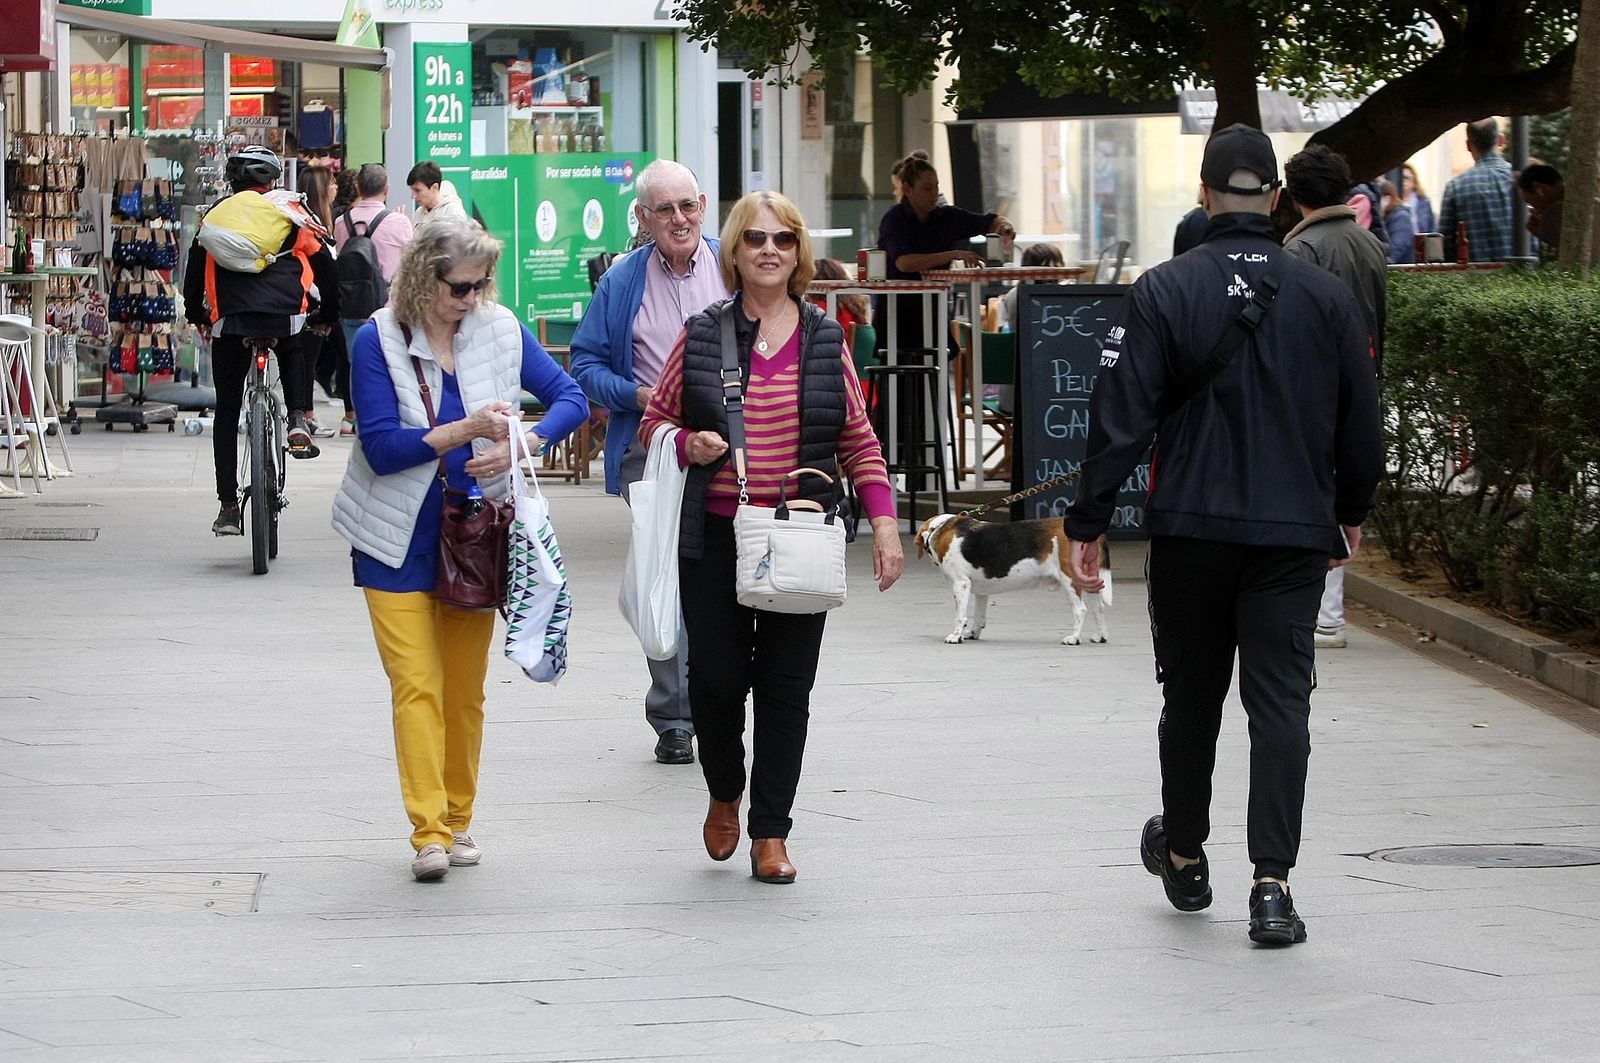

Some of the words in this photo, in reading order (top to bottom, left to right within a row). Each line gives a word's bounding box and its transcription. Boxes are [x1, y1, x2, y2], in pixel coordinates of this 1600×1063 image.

[425, 55, 451, 86] 9h
[455, 70, 464, 86] a
[425, 93, 463, 124] 22h
[428, 131, 438, 142] de
[438, 130, 457, 141] lunes
[458, 132, 463, 141] a
[430, 145, 461, 158] domingo
[471, 167, 507, 181] aturalidad
[546, 167, 559, 178] Por
[560, 168, 571, 178] ser
[572, 165, 591, 178] socio
[592, 165, 602, 177] de
[76, 225, 95, 234] ELVA
[1244, 253, 1268, 262] LCK
[1227, 285, 1242, 296] SK
[1041, 305, 1094, 336] 5€
[1036, 458, 1081, 486] JAM
